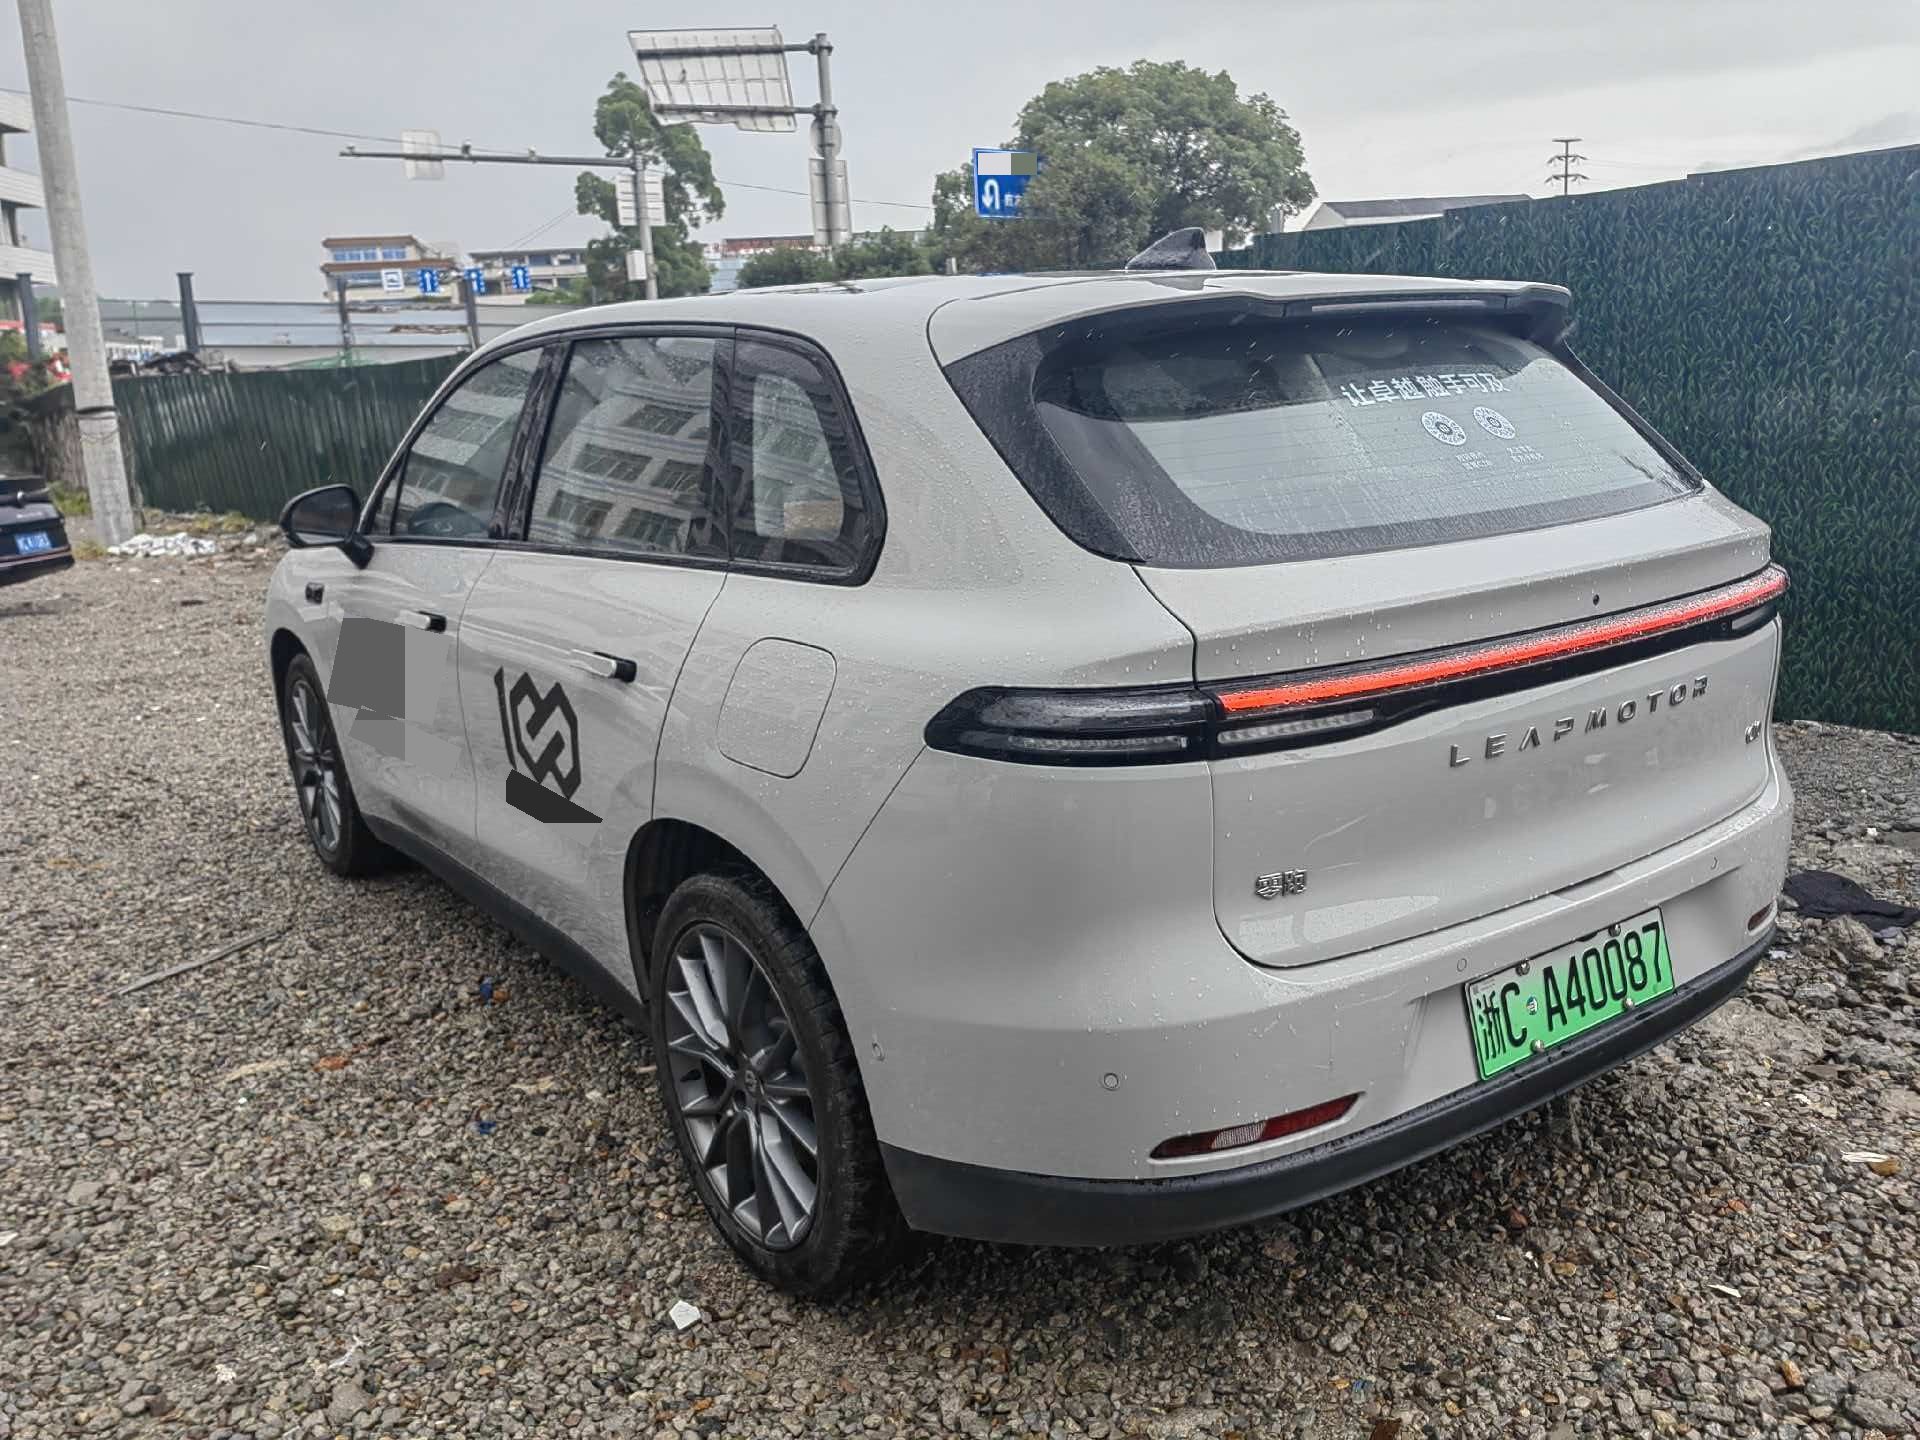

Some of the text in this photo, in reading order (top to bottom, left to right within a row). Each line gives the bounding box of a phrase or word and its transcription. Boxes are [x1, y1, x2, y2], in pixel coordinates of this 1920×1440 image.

[1339, 372, 1512, 407] 让卓越触手可及
[1450, 675, 1709, 768] LEAPMOTOR
